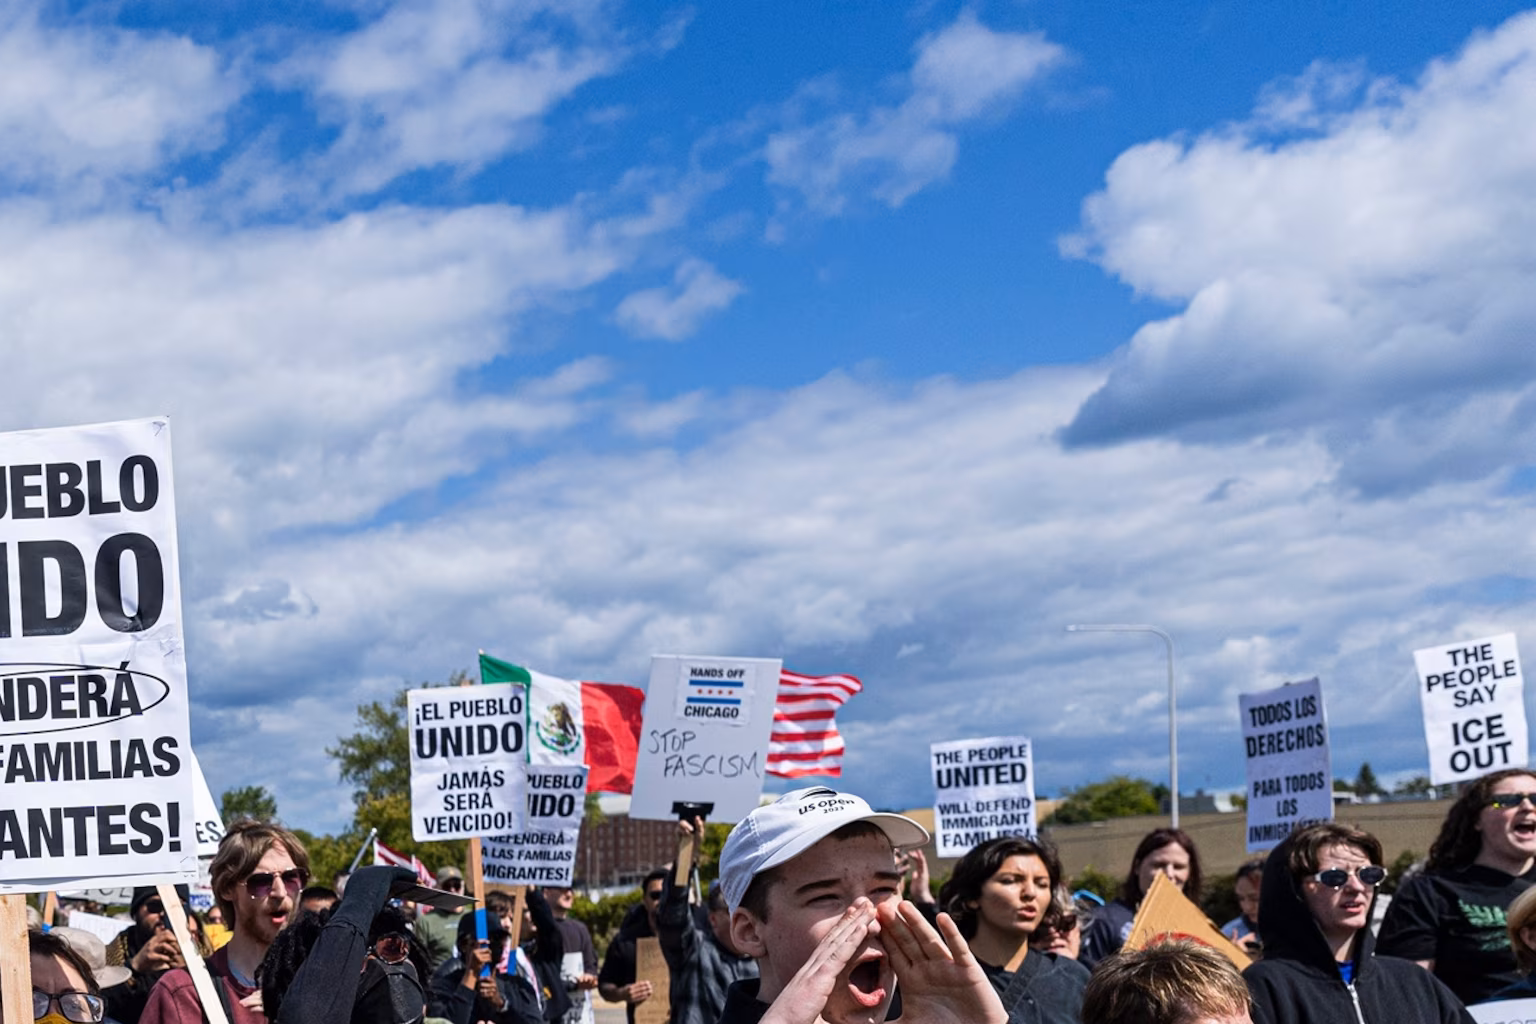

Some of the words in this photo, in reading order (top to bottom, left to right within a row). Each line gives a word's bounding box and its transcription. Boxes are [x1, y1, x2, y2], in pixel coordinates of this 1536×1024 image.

[1447, 643, 1493, 667] THE
[690, 668, 724, 679] HANDS
[727, 668, 745, 679] OFF
[1426, 660, 1516, 692] PEOPLE
[1454, 684, 1497, 708] SAY
[415, 703, 444, 725] ¡EL
[449, 696, 522, 719] PUEBLO
[684, 706, 739, 718] CHICAGO
[1249, 700, 1292, 728] TODOS
[1295, 694, 1317, 719] LOS
[415, 721, 523, 759] UNIDO
[648, 728, 696, 754] STOP
[1246, 723, 1325, 758] DERECHOS
[1452, 714, 1505, 746] ICE
[664, 752, 760, 778] FASCISM
[934, 751, 963, 765] THE
[968, 744, 1027, 762] PEOPLE
[1450, 741, 1512, 773] OUT
[437, 766, 505, 791] JAMÁS
[936, 763, 1027, 789] UNITED
[1253, 777, 1282, 798] PARA
[1285, 772, 1325, 794] TODOS
[443, 787, 493, 812] SERÁ
[528, 793, 575, 818] IDO
[823, 806, 844, 814] 2023
[938, 803, 971, 815] WILL
[976, 798, 1031, 813] DEFEND
[1277, 798, 1298, 817] LOS
[423, 812, 512, 835] VENCIDO!
[942, 812, 1030, 830] IMMIGRANT
[492, 847, 514, 860] LAS
[517, 850, 572, 861] FAMILIAS
